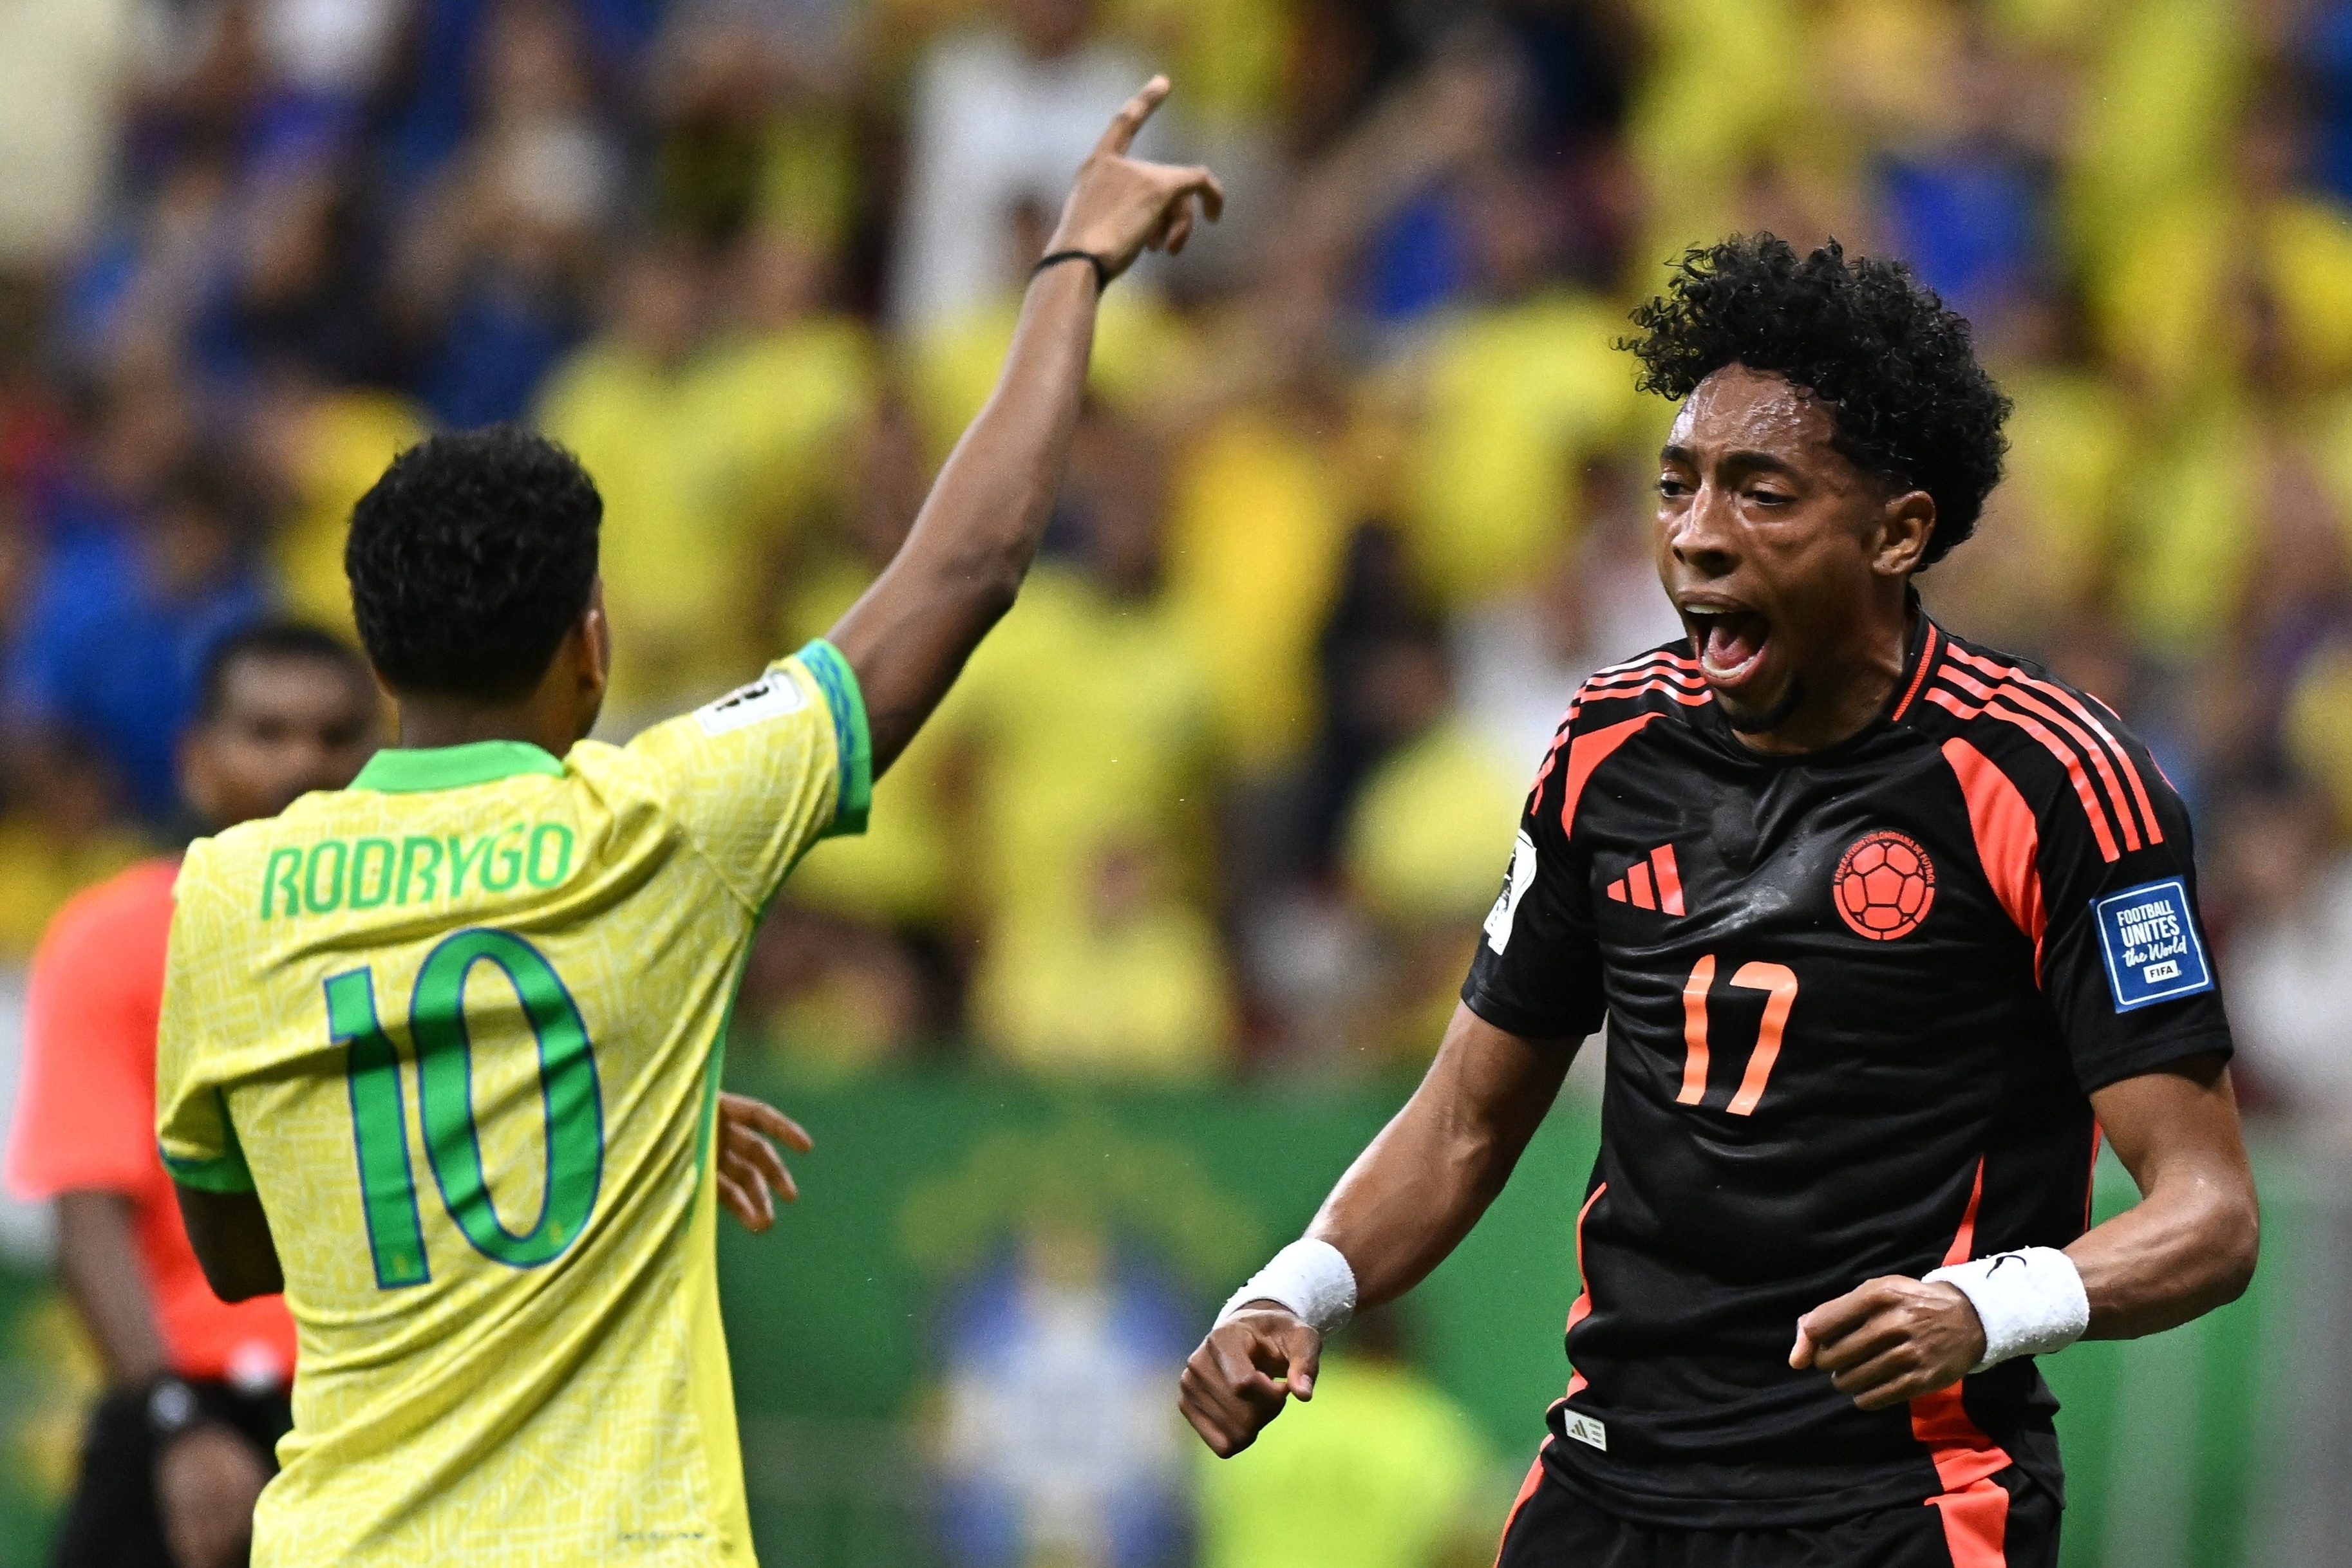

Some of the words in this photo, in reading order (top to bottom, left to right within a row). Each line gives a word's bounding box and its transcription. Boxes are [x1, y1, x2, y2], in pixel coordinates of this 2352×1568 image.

[261, 822, 573, 920] RODRYGO
[2116, 899, 2174, 926] FOOTBALL
[2120, 915, 2180, 947] UNITES
[2122, 947, 2147, 967] the
[2147, 935, 2187, 961] World
[2149, 965, 2174, 978] FIFA
[1676, 954, 1798, 1116] 17
[323, 928, 604, 1290] 10
